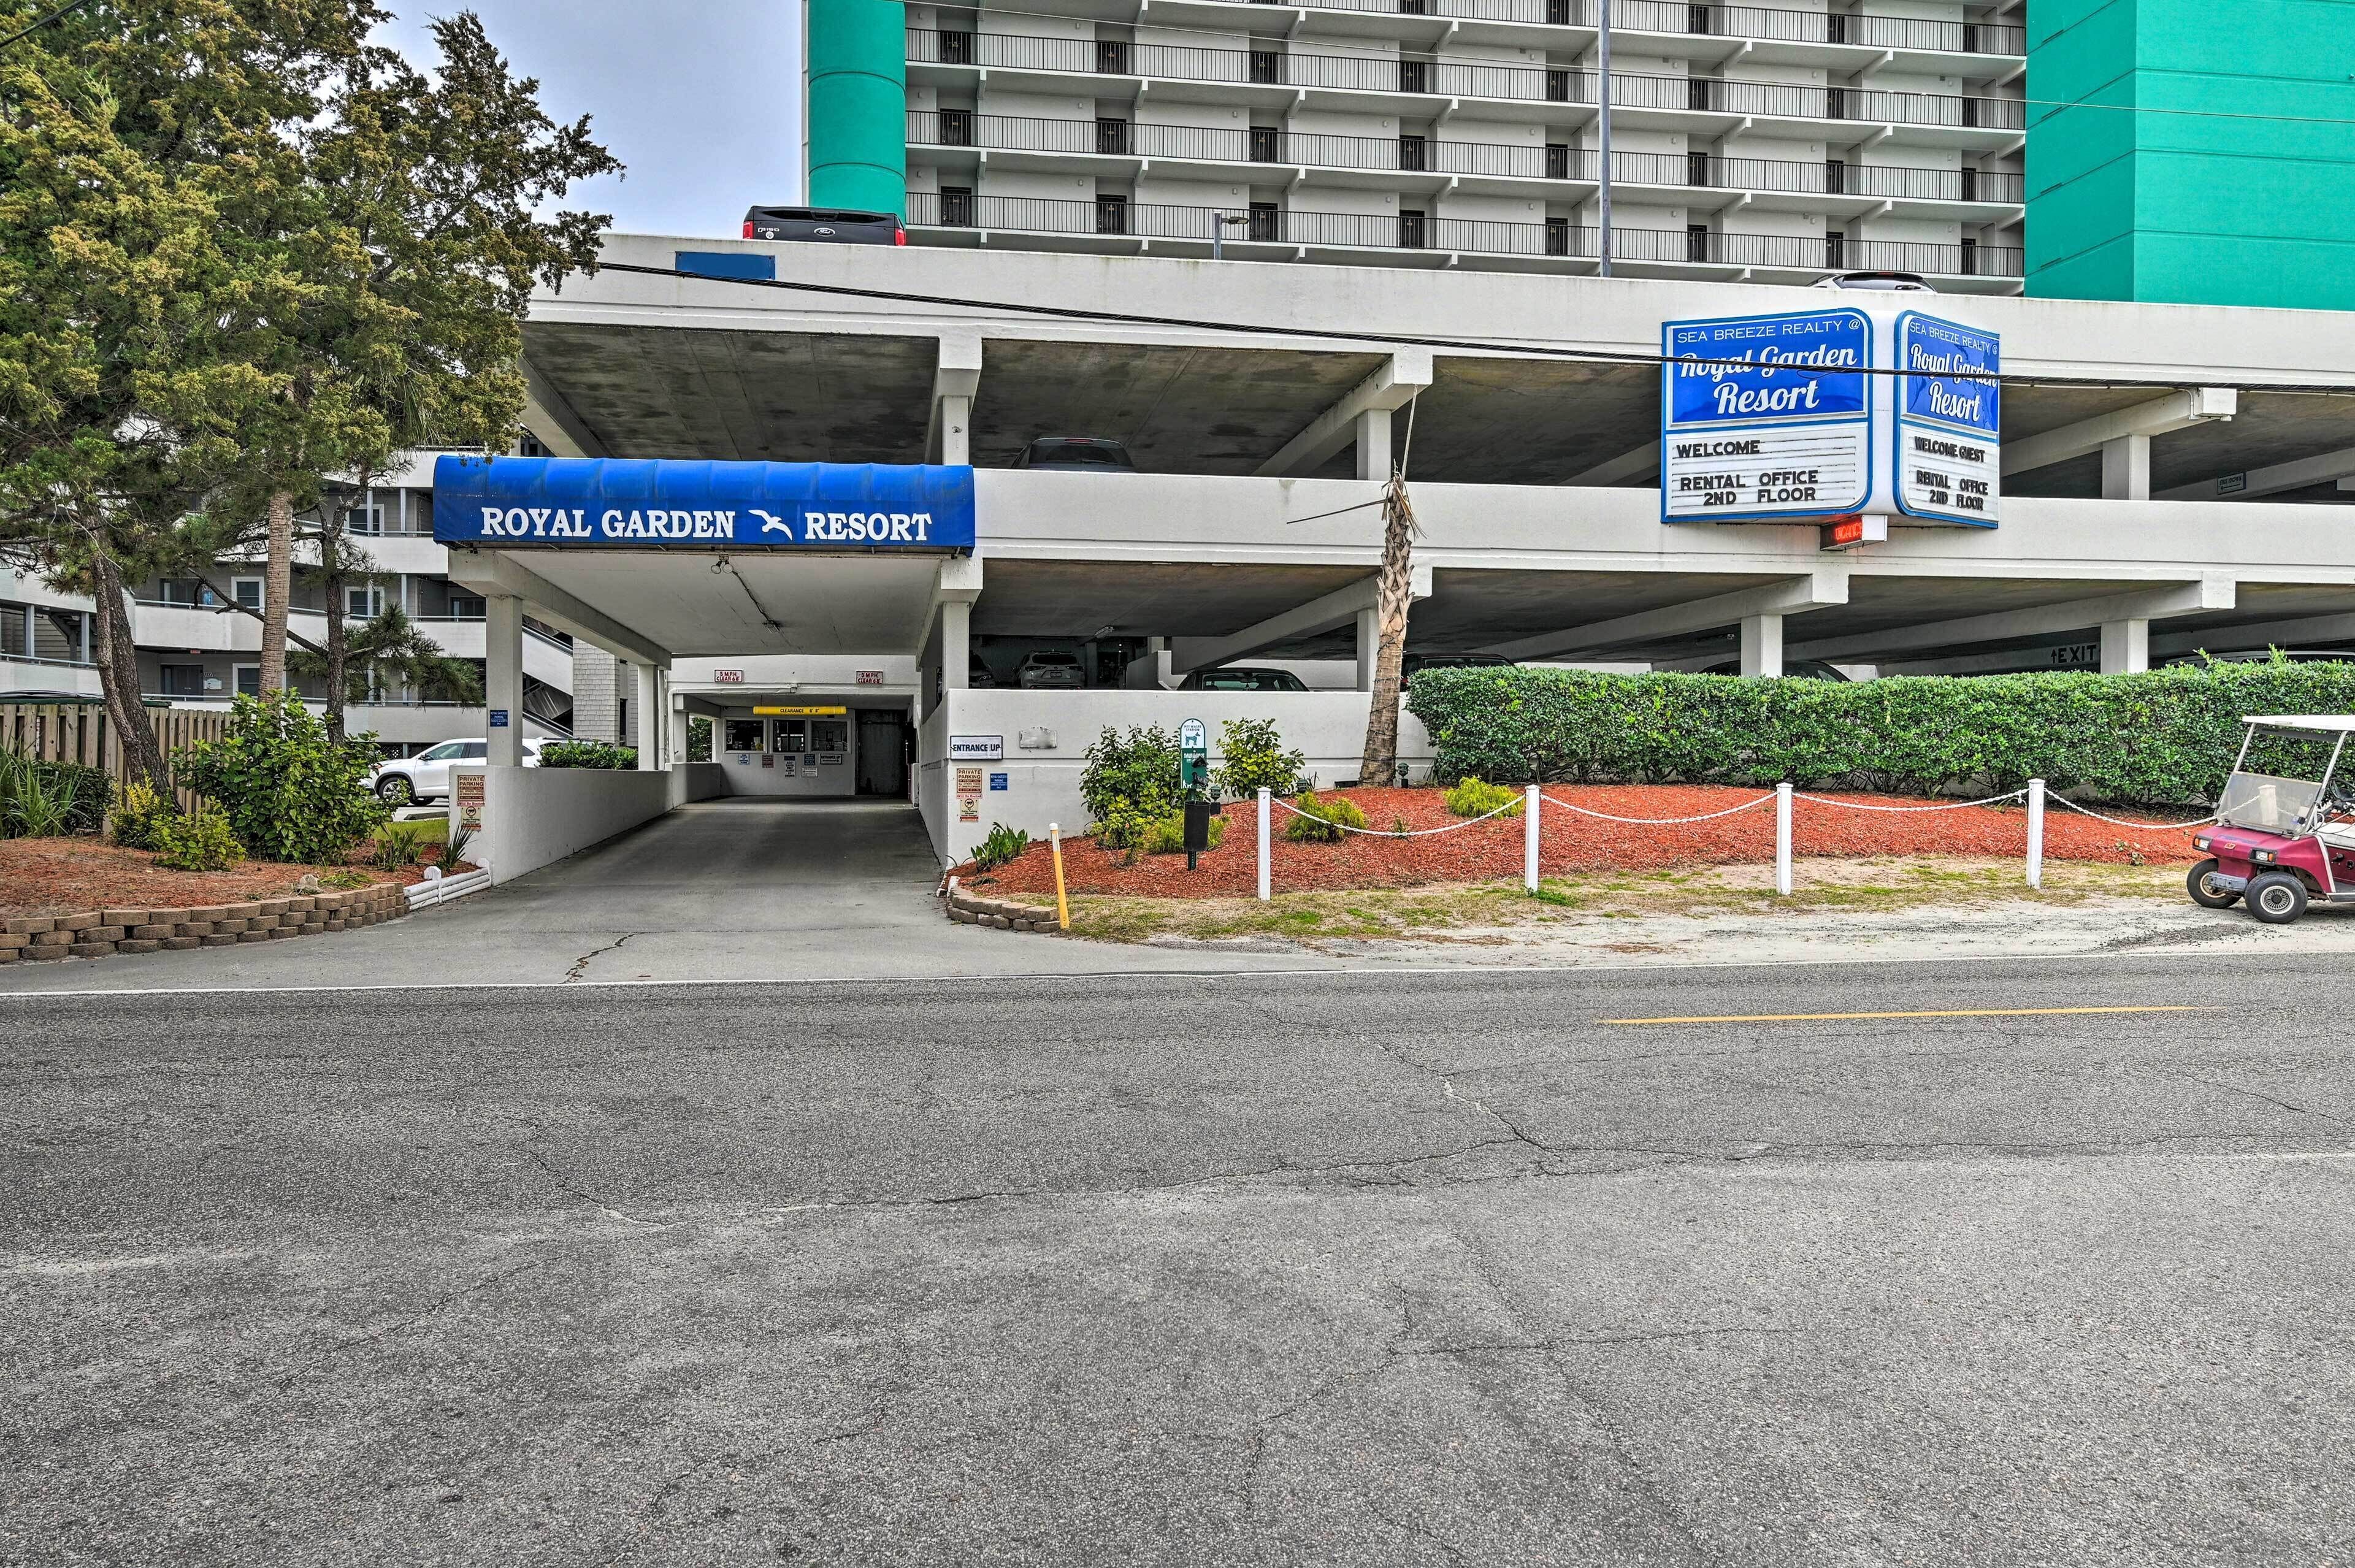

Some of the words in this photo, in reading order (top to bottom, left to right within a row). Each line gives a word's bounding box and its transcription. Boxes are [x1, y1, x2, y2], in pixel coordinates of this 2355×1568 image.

[1677, 331, 1707, 343] SEA
[1714, 325, 1776, 340] BREEZE
[1782, 319, 1842, 335] REALTY
[1848, 319, 1861, 330] @
[1910, 321, 1926, 335] SEA
[1929, 326, 1960, 345] BREEZE
[1962, 336, 1991, 354] REALTY
[1678, 349, 1753, 382] Royal
[1760, 343, 1857, 378] Garden
[1910, 343, 1951, 380] Royal
[1953, 354, 1997, 388] Garden
[1714, 380, 1820, 415] Resort
[1929, 381, 1980, 422] Resort
[1676, 440, 1761, 458] WELCOME
[1914, 436, 1958, 457] WELCOME
[1959, 445, 1985, 462] GUEST
[1680, 474, 1746, 491] RENTAL
[1758, 470, 1818, 486] OFFICE
[1916, 470, 1951, 489] RENTAL
[1959, 478, 1988, 495] OFFICE
[1703, 491, 1737, 506] 2ND
[1757, 487, 1816, 503] FLOOR
[1929, 489, 1948, 505] 2ND
[1956, 494, 1984, 511] FLOOR
[481, 507, 592, 537] ROYAL
[601, 510, 735, 538] GARDEN
[805, 512, 933, 541] RESORT
[2058, 644, 2097, 663] EXIT
